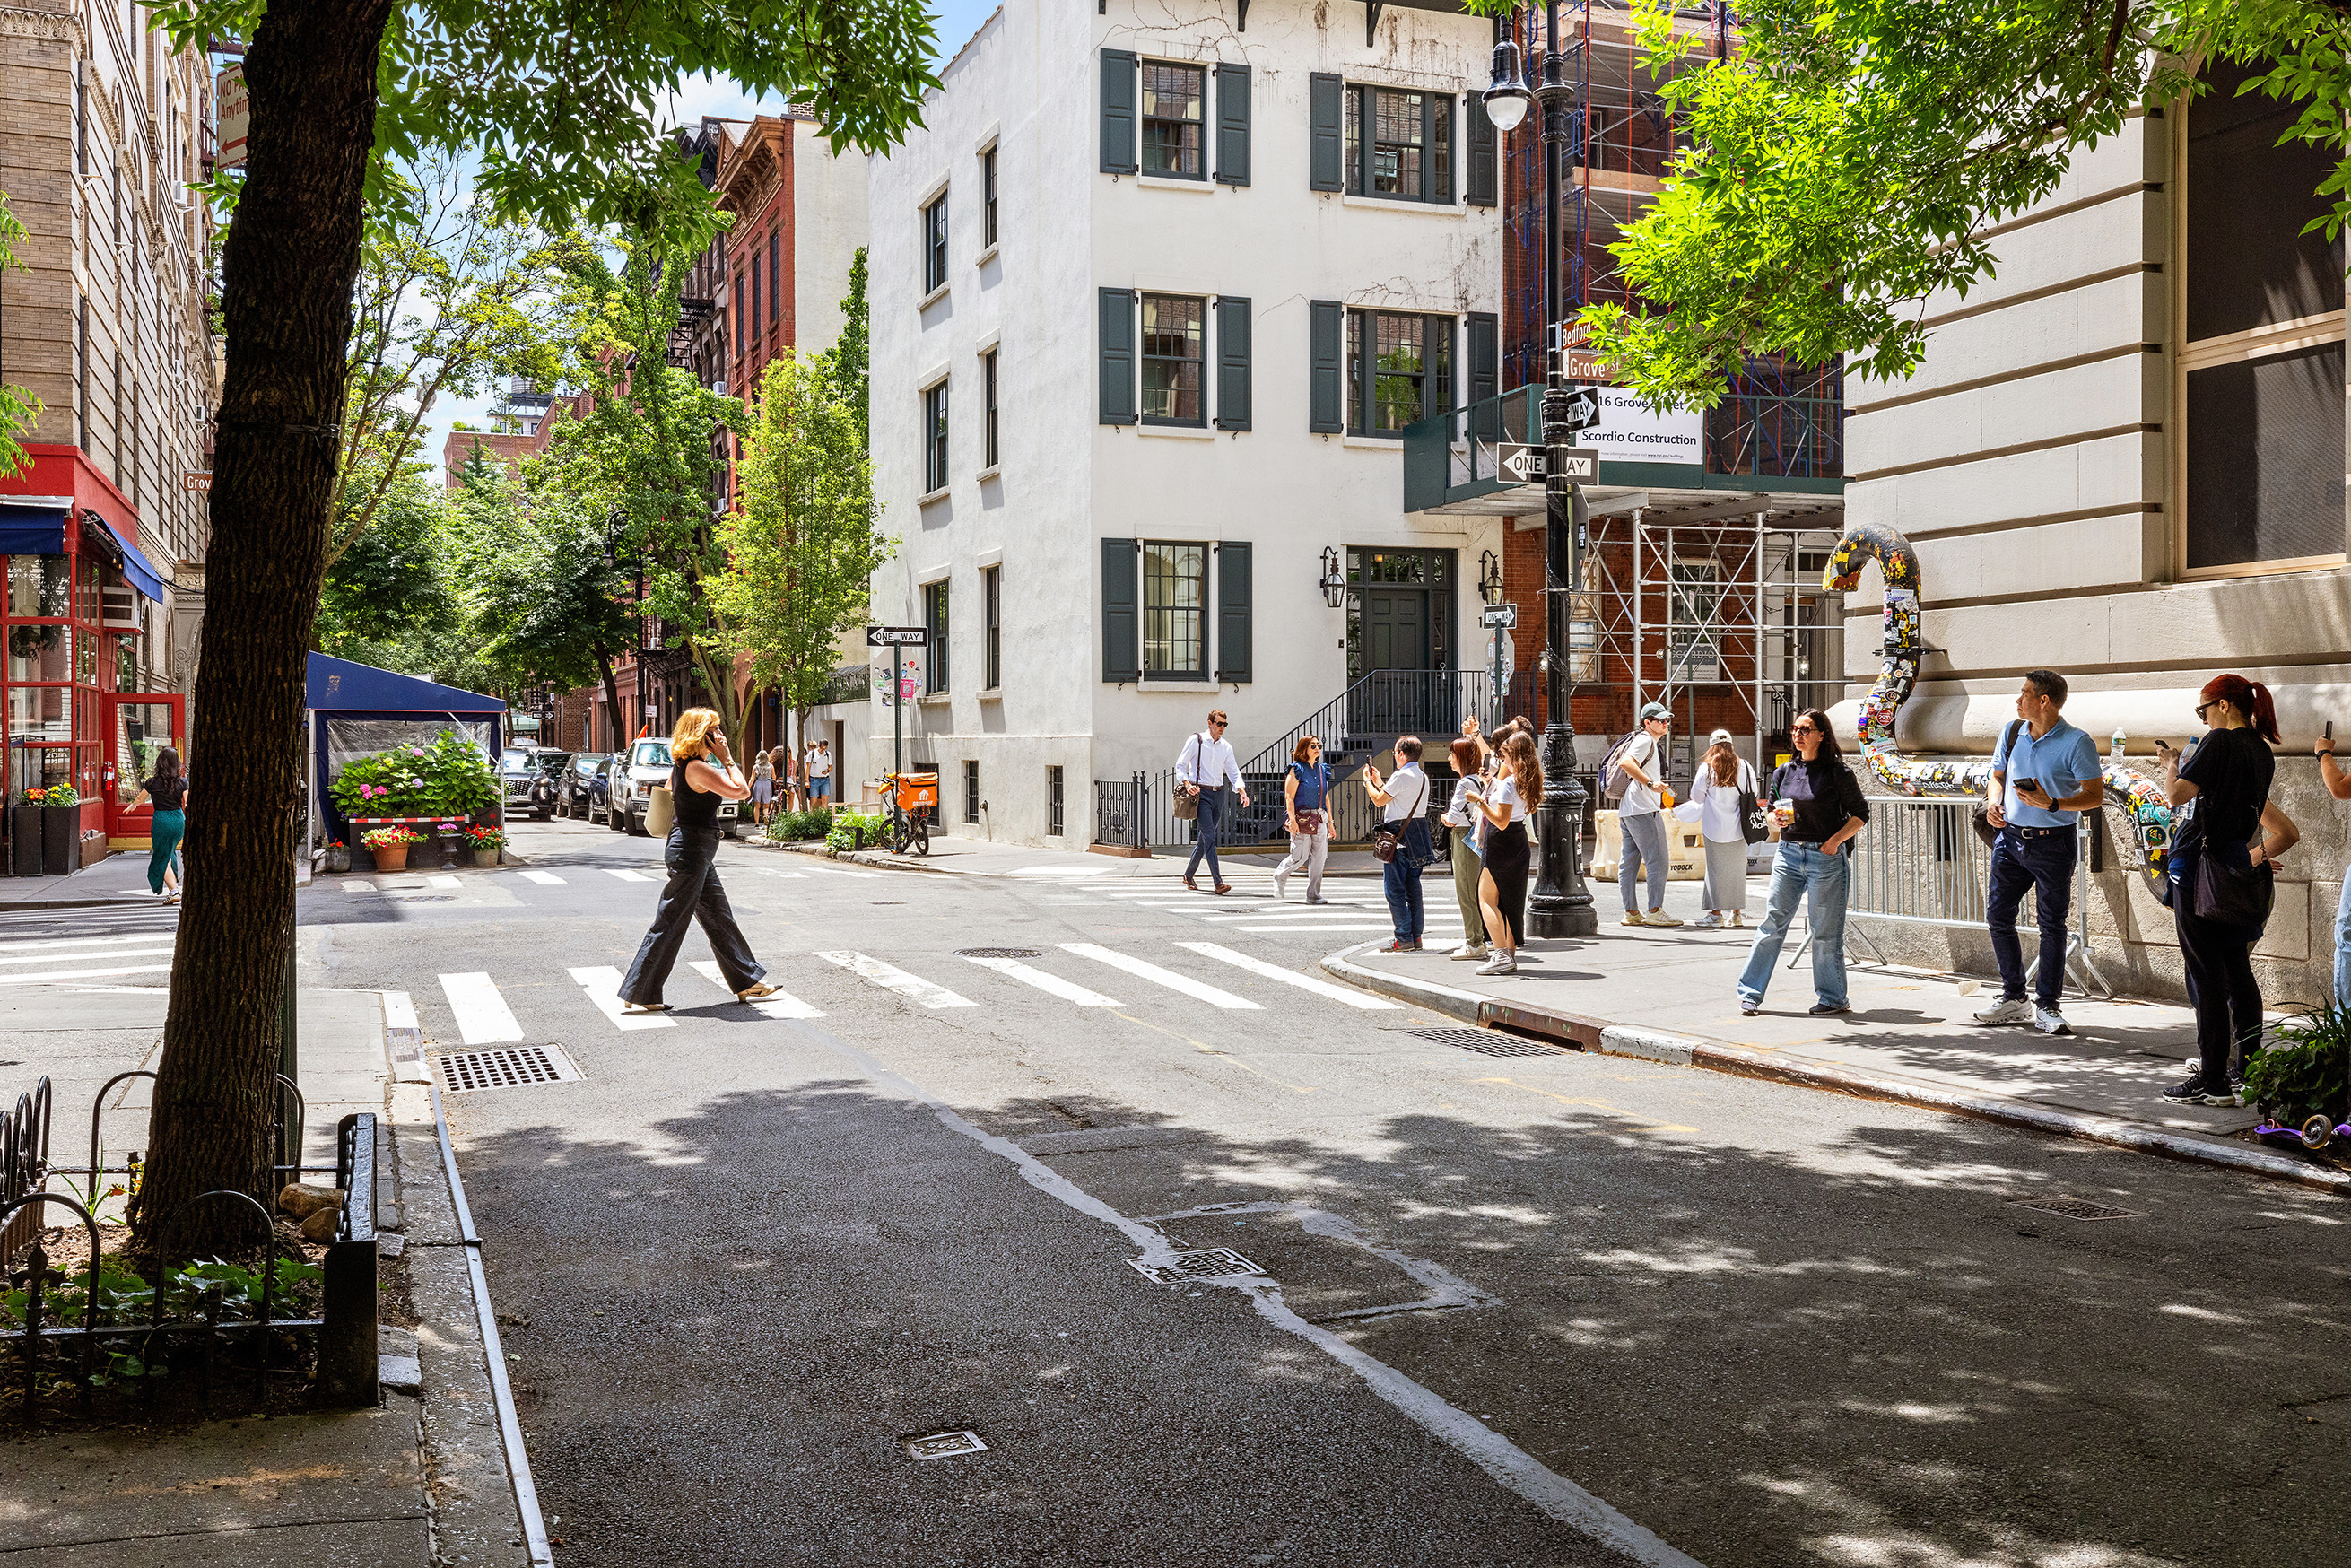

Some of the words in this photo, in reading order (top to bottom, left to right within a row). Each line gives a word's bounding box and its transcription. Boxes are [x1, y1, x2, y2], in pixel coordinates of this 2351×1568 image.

[221, 79, 231, 99] NO
[221, 97, 249, 120] Anytim
[1563, 321, 1591, 347] Bedford
[1570, 358, 1606, 378] Grove
[1572, 401, 1589, 420] WAY
[1598, 396, 1612, 407] 16
[1614, 396, 1649, 408] Grove
[1582, 431, 1624, 442] Scordio
[1627, 431, 1697, 446] Construction
[1514, 457, 1542, 472] ONE
[1567, 459, 1585, 475] AY
[187, 475, 211, 489] Grov
[875, 632, 893, 641] ONE
[901, 632, 919, 641] WAY
[1670, 863, 1694, 871] YODOCK
